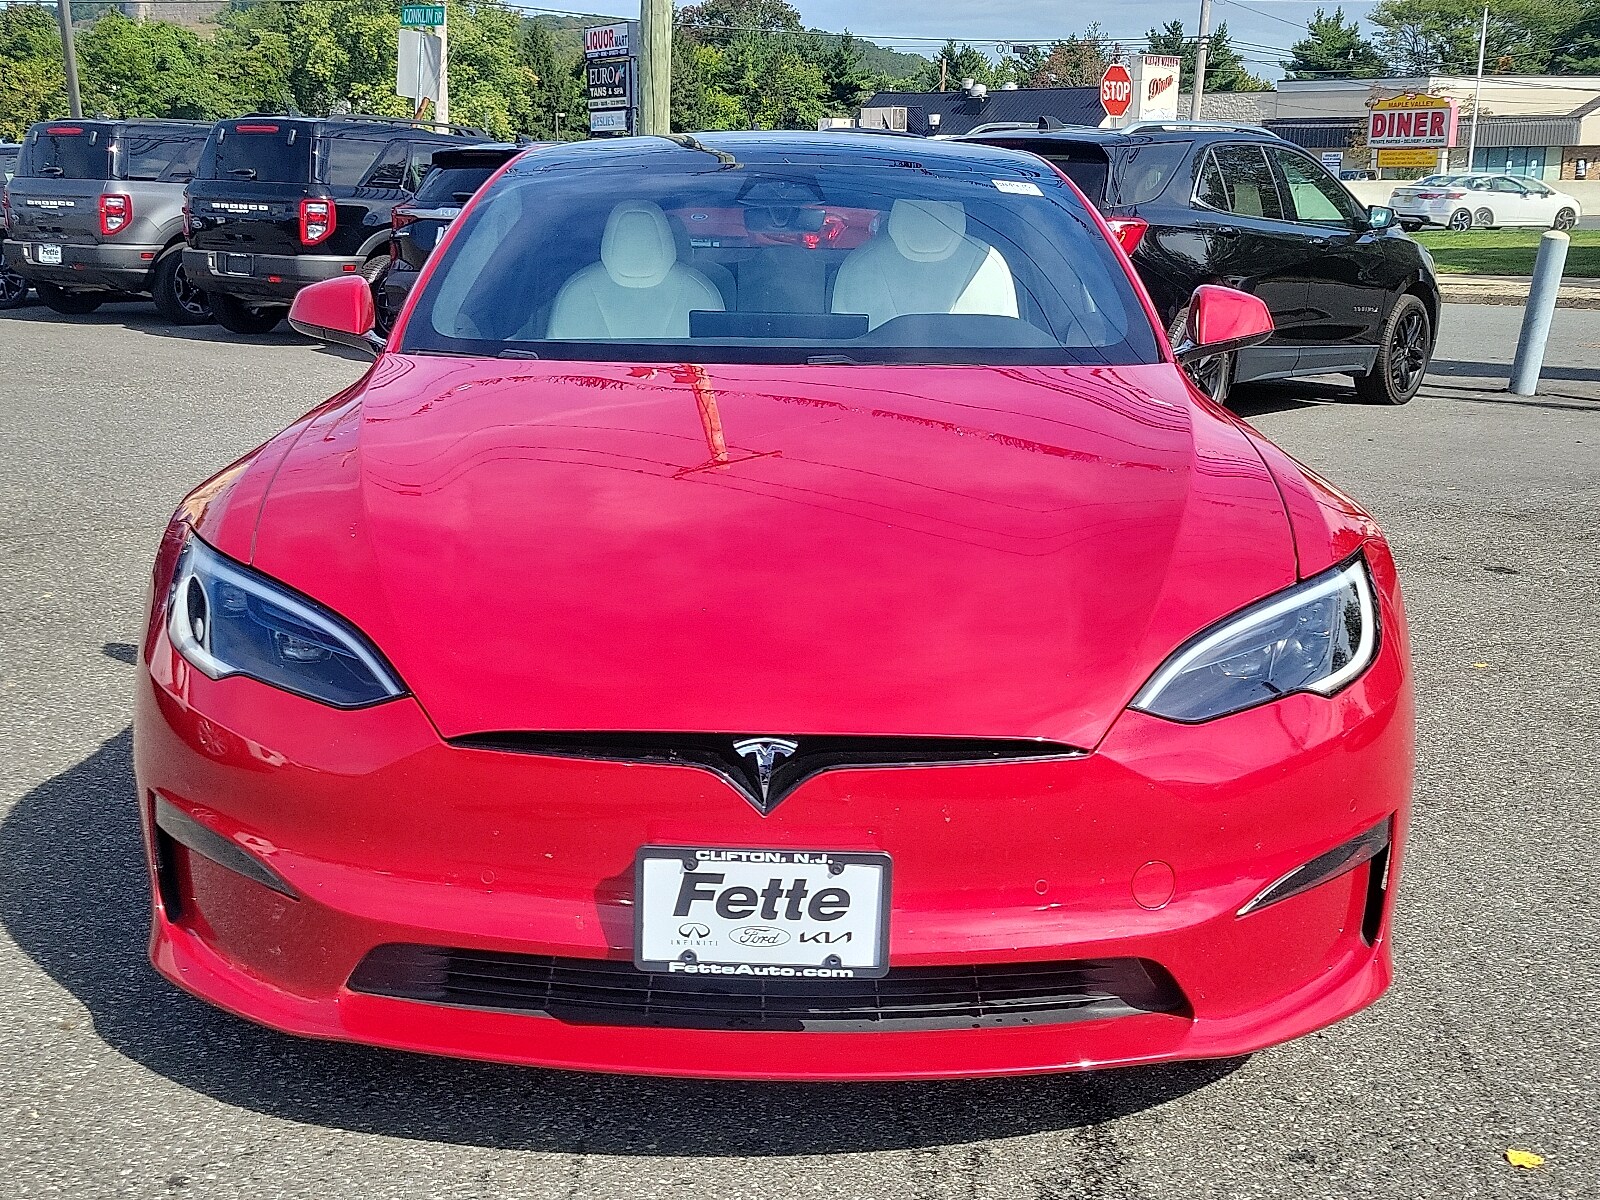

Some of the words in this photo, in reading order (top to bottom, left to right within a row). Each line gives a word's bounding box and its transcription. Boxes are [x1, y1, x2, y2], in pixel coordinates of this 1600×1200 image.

[404, 9, 433, 23] CONKLIN
[434, 12, 442, 23] DR
[586, 29, 614, 50] LIQUOR
[615, 35, 628, 46] MART
[589, 66, 615, 85] EURO
[590, 87, 607, 97] TANS
[614, 87, 624, 95] SPA
[1103, 81, 1131, 101] STOP
[1372, 112, 1445, 137] DINER
[212, 203, 269, 211] BRONCO
[42, 246, 59, 255] Fette
[695, 851, 786, 863] CLIFTON,
[793, 853, 833, 864] N.J.
[672, 871, 851, 922] Fette
[671, 939, 718, 947] INFINITI
[740, 928, 780, 944] Ford
[800, 931, 853, 944] KIA
[668, 962, 854, 977] FetteAuto.com
